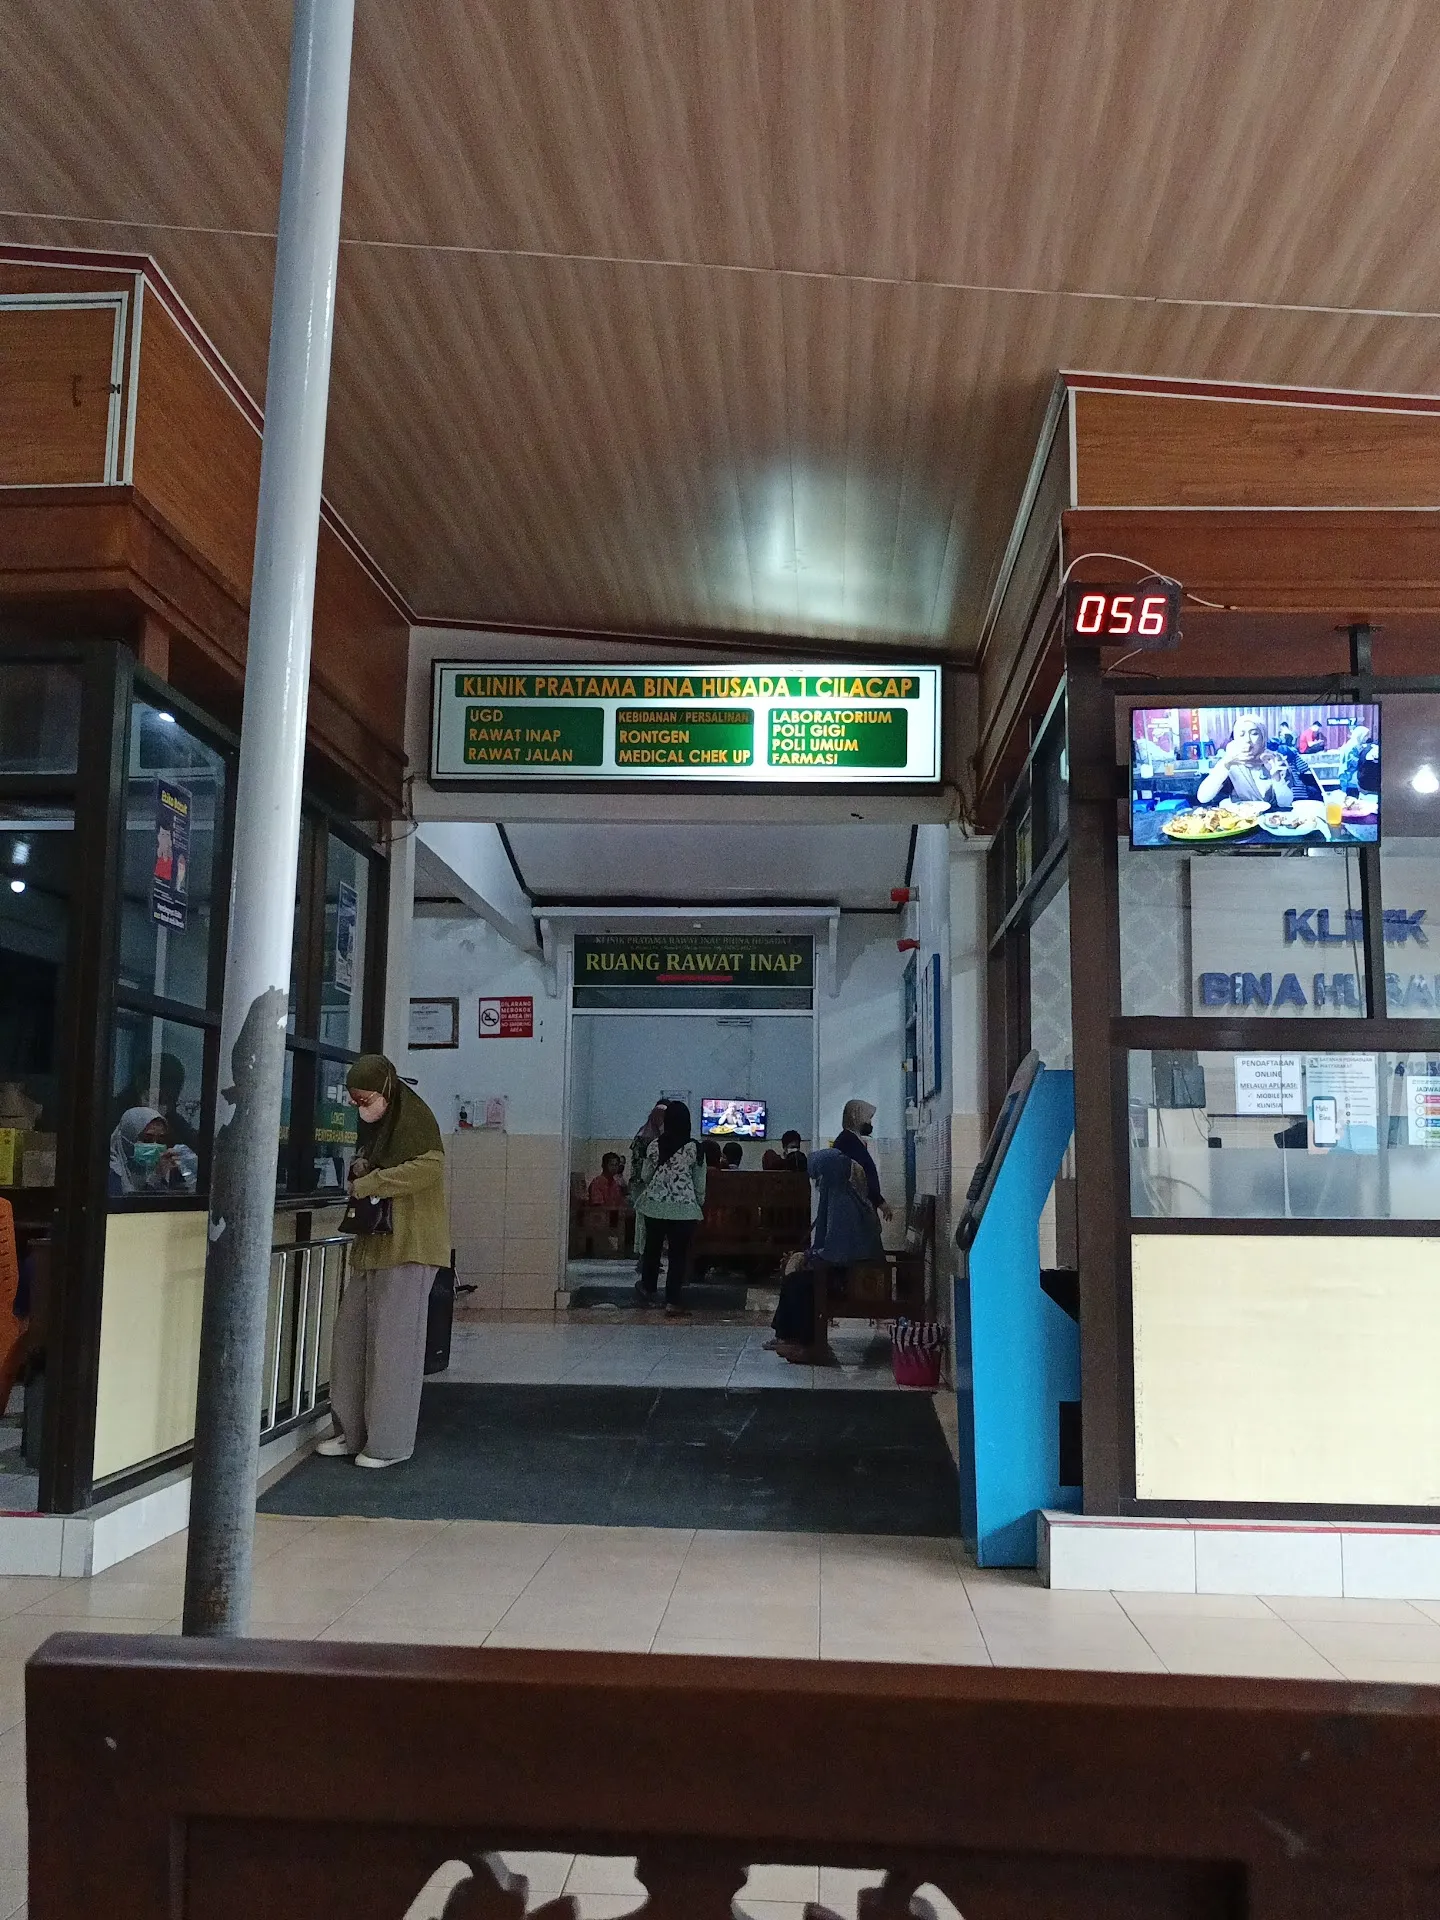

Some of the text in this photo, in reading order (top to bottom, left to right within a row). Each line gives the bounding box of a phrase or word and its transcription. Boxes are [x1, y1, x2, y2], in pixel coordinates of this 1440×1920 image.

[1076, 596, 1166, 634] 056
[463, 677, 913, 698] KLINIK PRATAMA BINA HUSADA 1 CILACAP
[470, 709, 504, 722] UGD
[618, 711, 677, 723] KEBIDANAN
[772, 710, 892, 723] LABORATORIUM
[469, 729, 561, 742] RAWAT INAP
[619, 730, 690, 744] RONTGEN
[772, 724, 845, 737] POLI GIGI
[772, 738, 859, 752] POLI UMUM
[468, 748, 573, 762] RAWAT JALAN
[619, 750, 751, 763] MEDICAL CHEK UP
[771, 753, 838, 765] FARMASI
[586, 953, 803, 972] RUANG RAWAT INAP
[1202, 972, 1308, 1007] BINA
